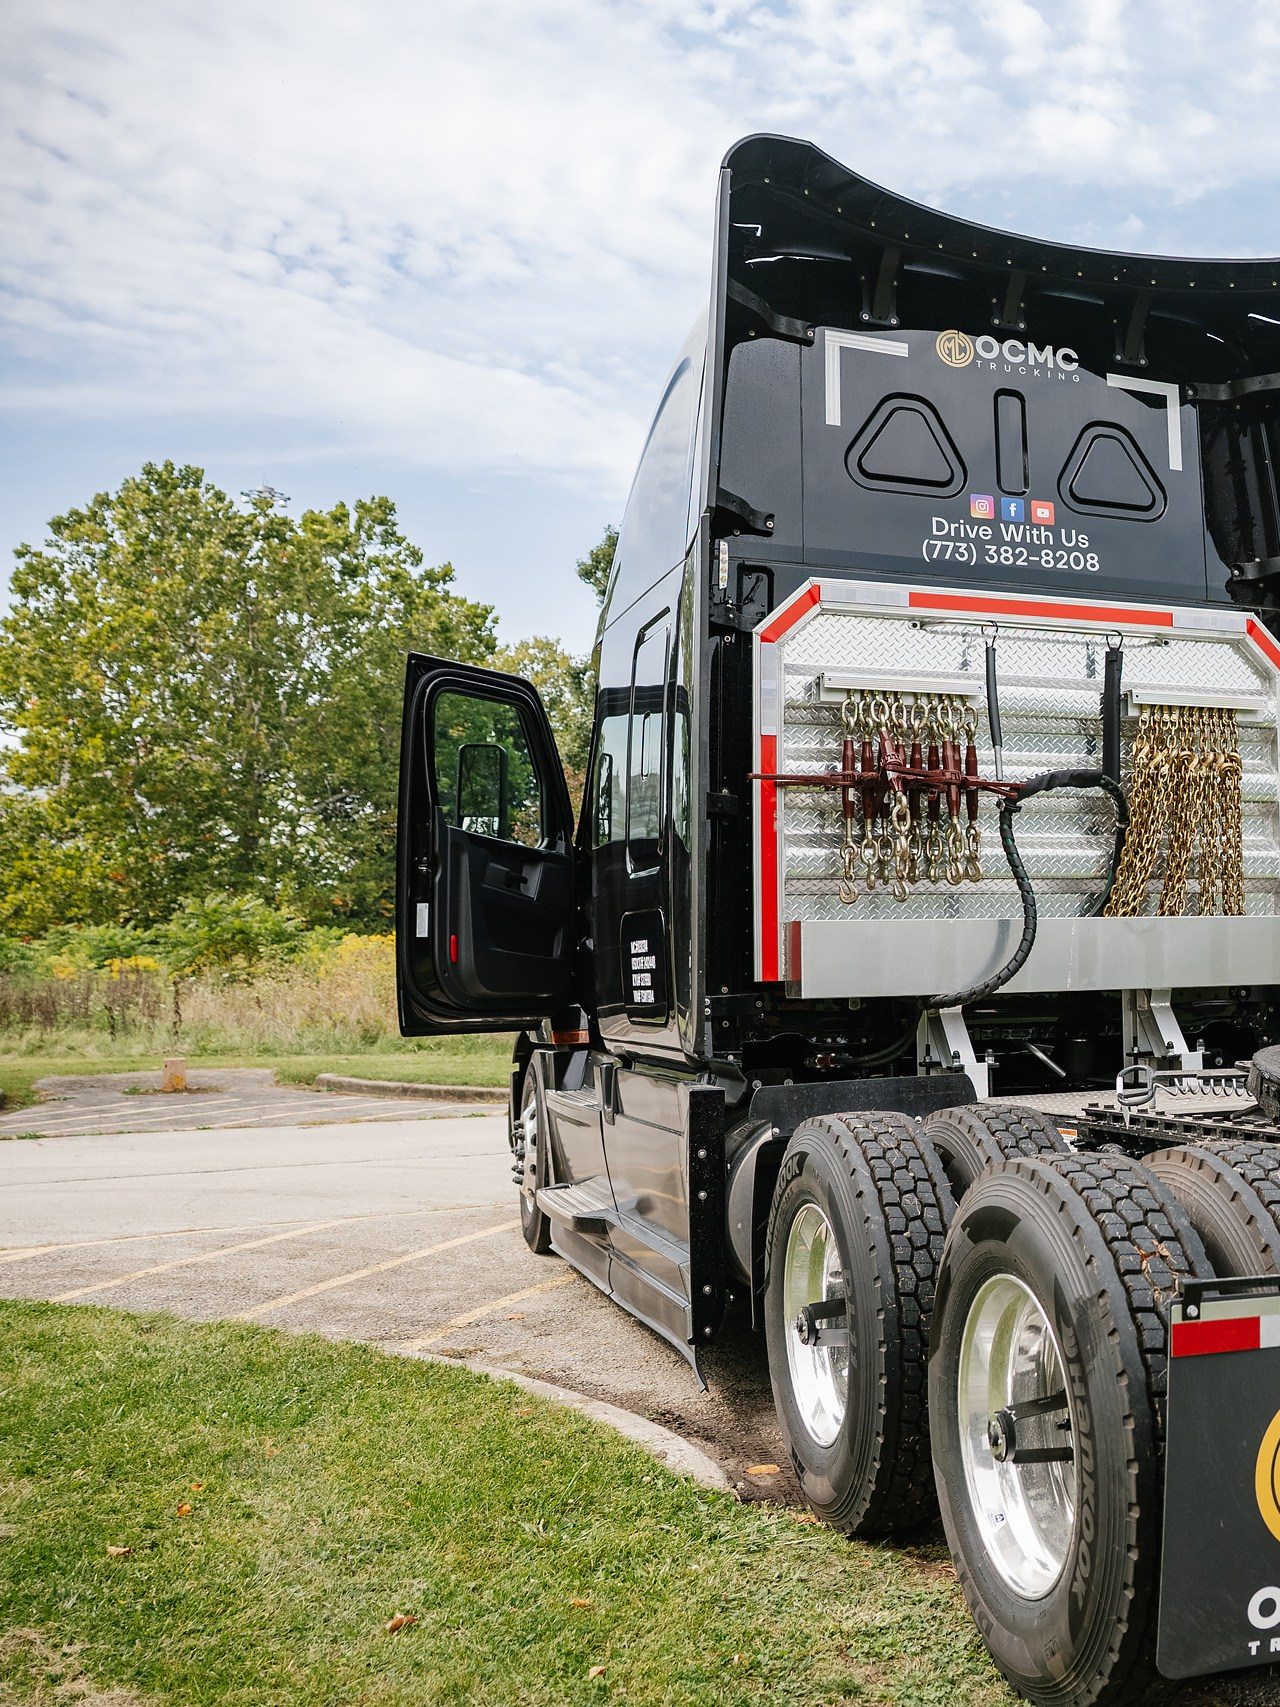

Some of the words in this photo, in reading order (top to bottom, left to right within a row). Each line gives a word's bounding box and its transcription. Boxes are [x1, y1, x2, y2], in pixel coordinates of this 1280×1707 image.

[975, 335, 1079, 372] OCMC
[975, 359, 1080, 383] TRUCKING
[931, 515, 994, 540] Drive
[999, 521, 1055, 546] With
[1060, 528, 1089, 549] Us
[922, 538, 977, 566] (773)
[984, 544, 1100, 572] 382-8208
